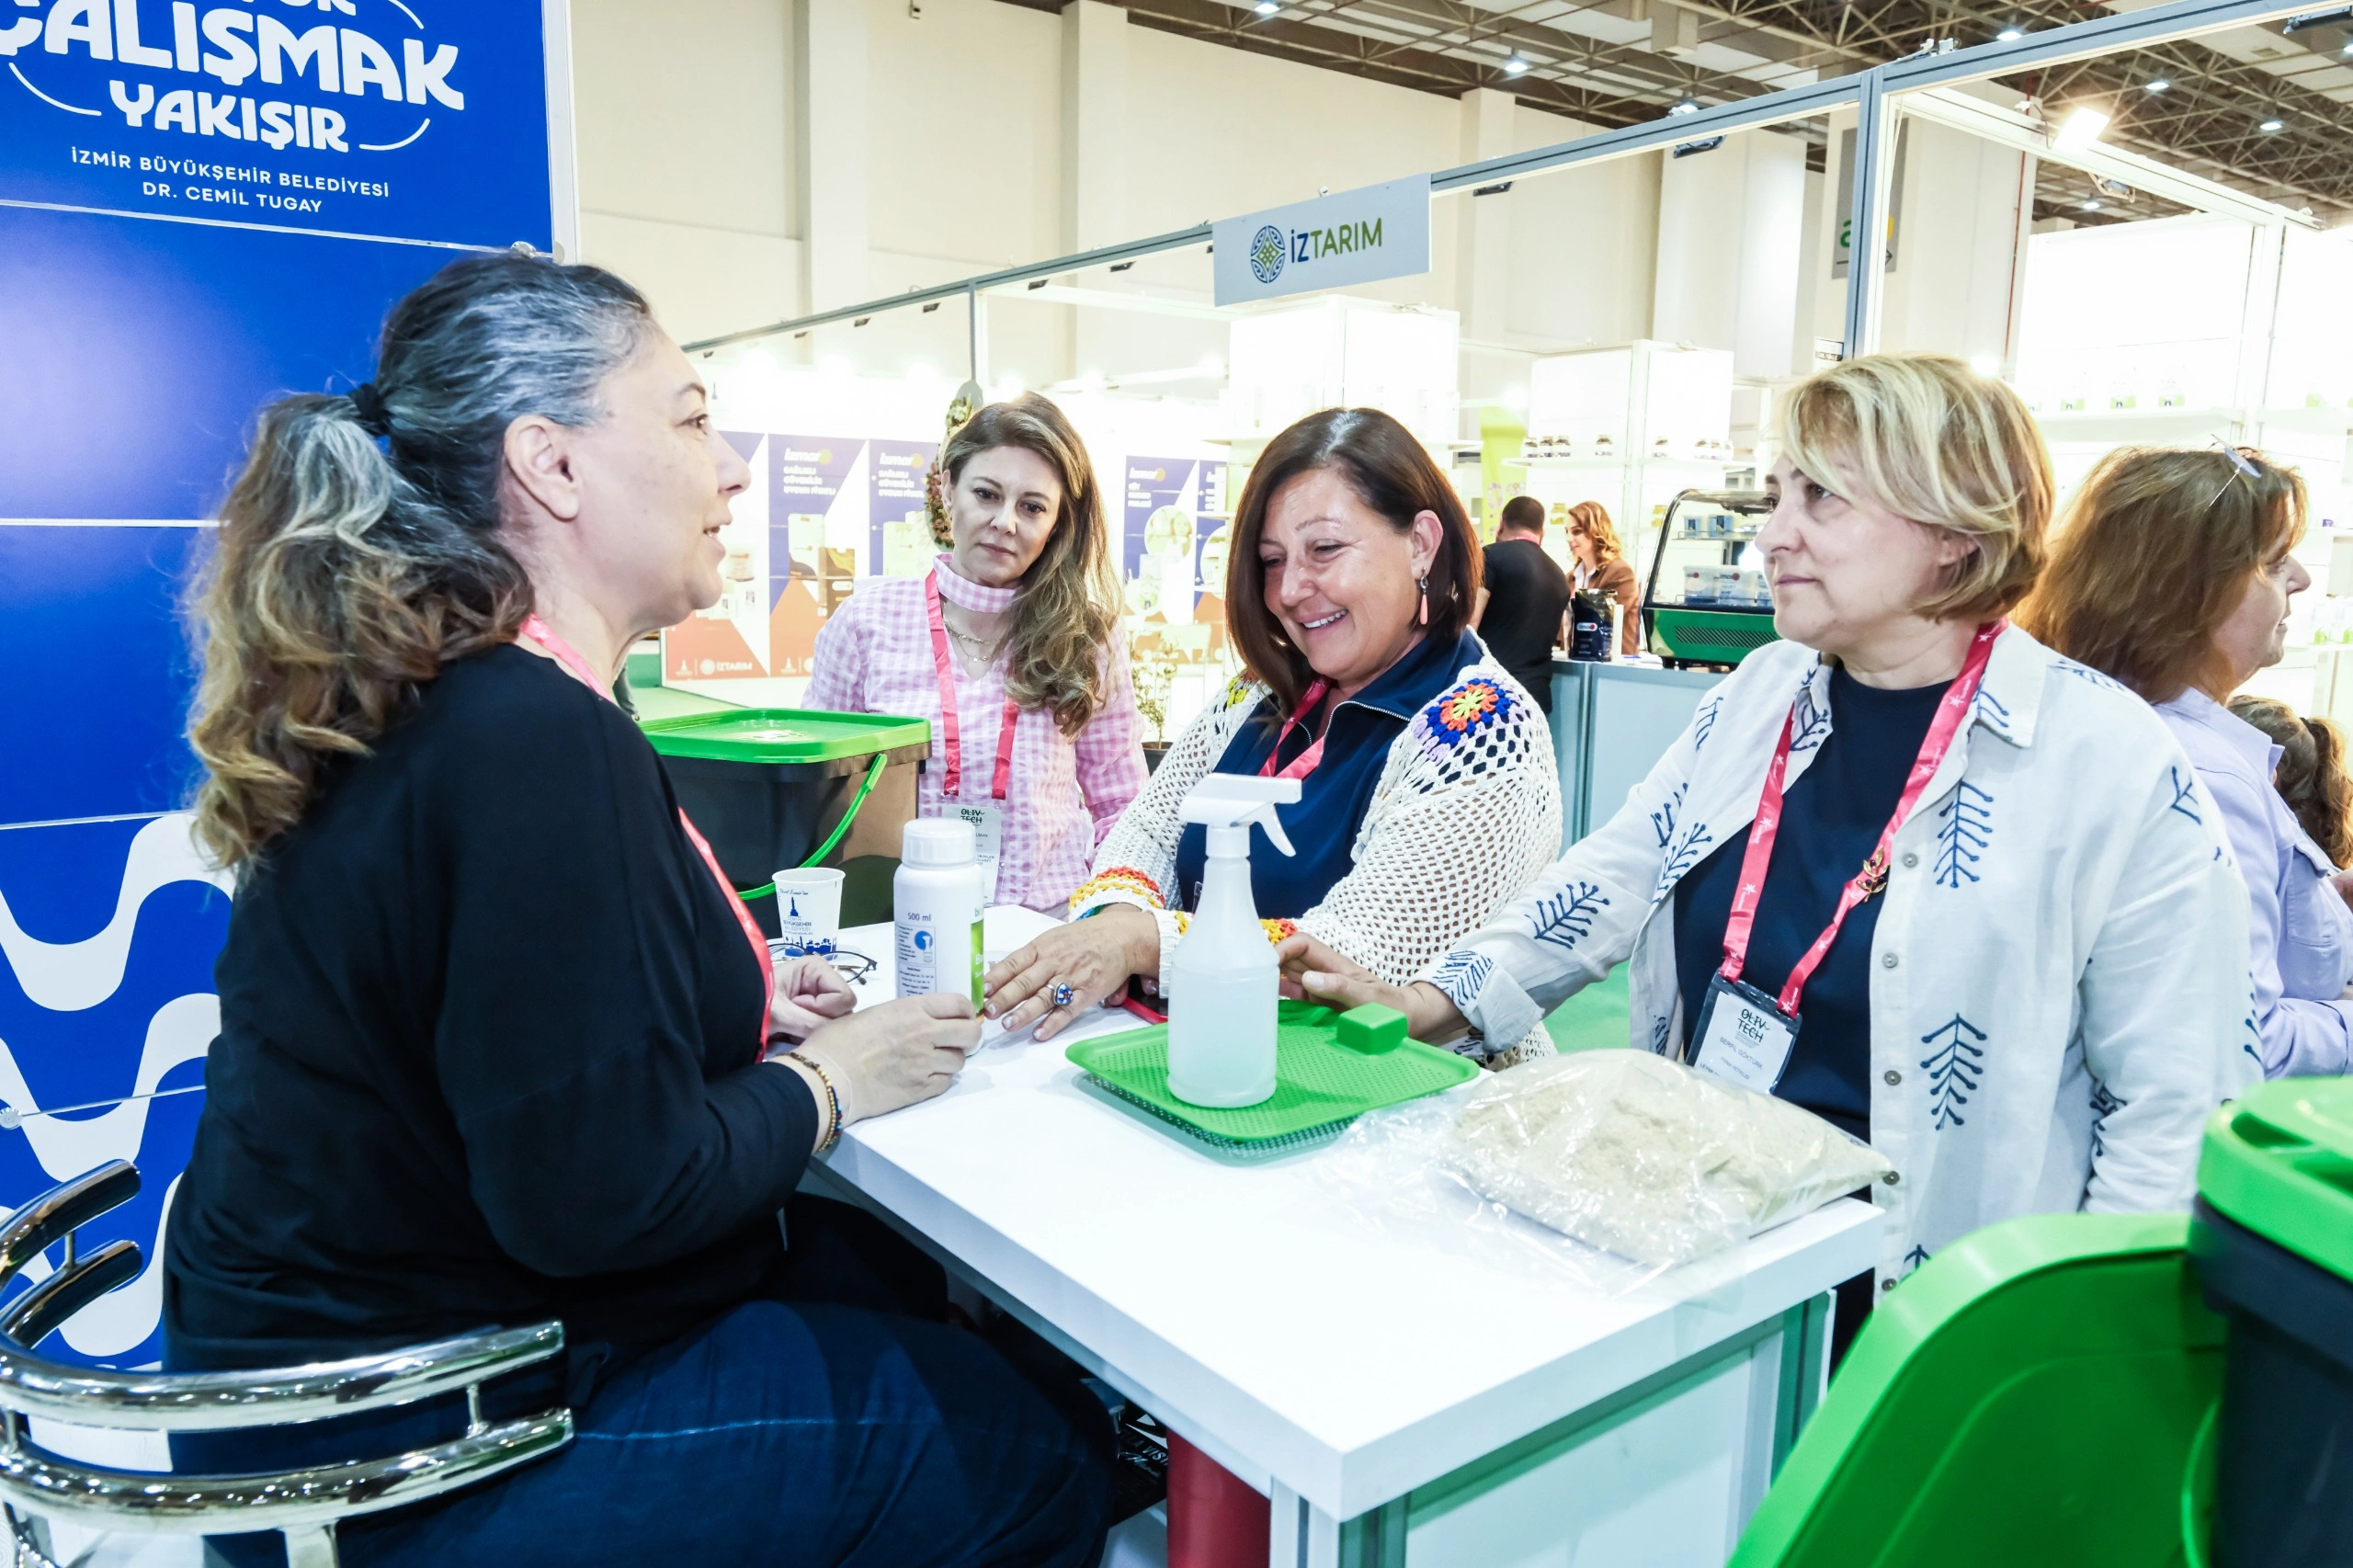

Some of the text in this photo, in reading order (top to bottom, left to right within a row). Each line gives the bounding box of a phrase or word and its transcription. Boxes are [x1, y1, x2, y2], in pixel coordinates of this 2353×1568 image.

[109, 80, 348, 153] YAKIŞIR
[72, 147, 389, 198] İZMİR BÜYÜKŞEHİR BELEDİYESİ
[142, 182, 322, 213] DR. CEMİL TUGAY
[908, 913, 932, 922] 500 ml
[1737, 1017, 1764, 1043] TECH
